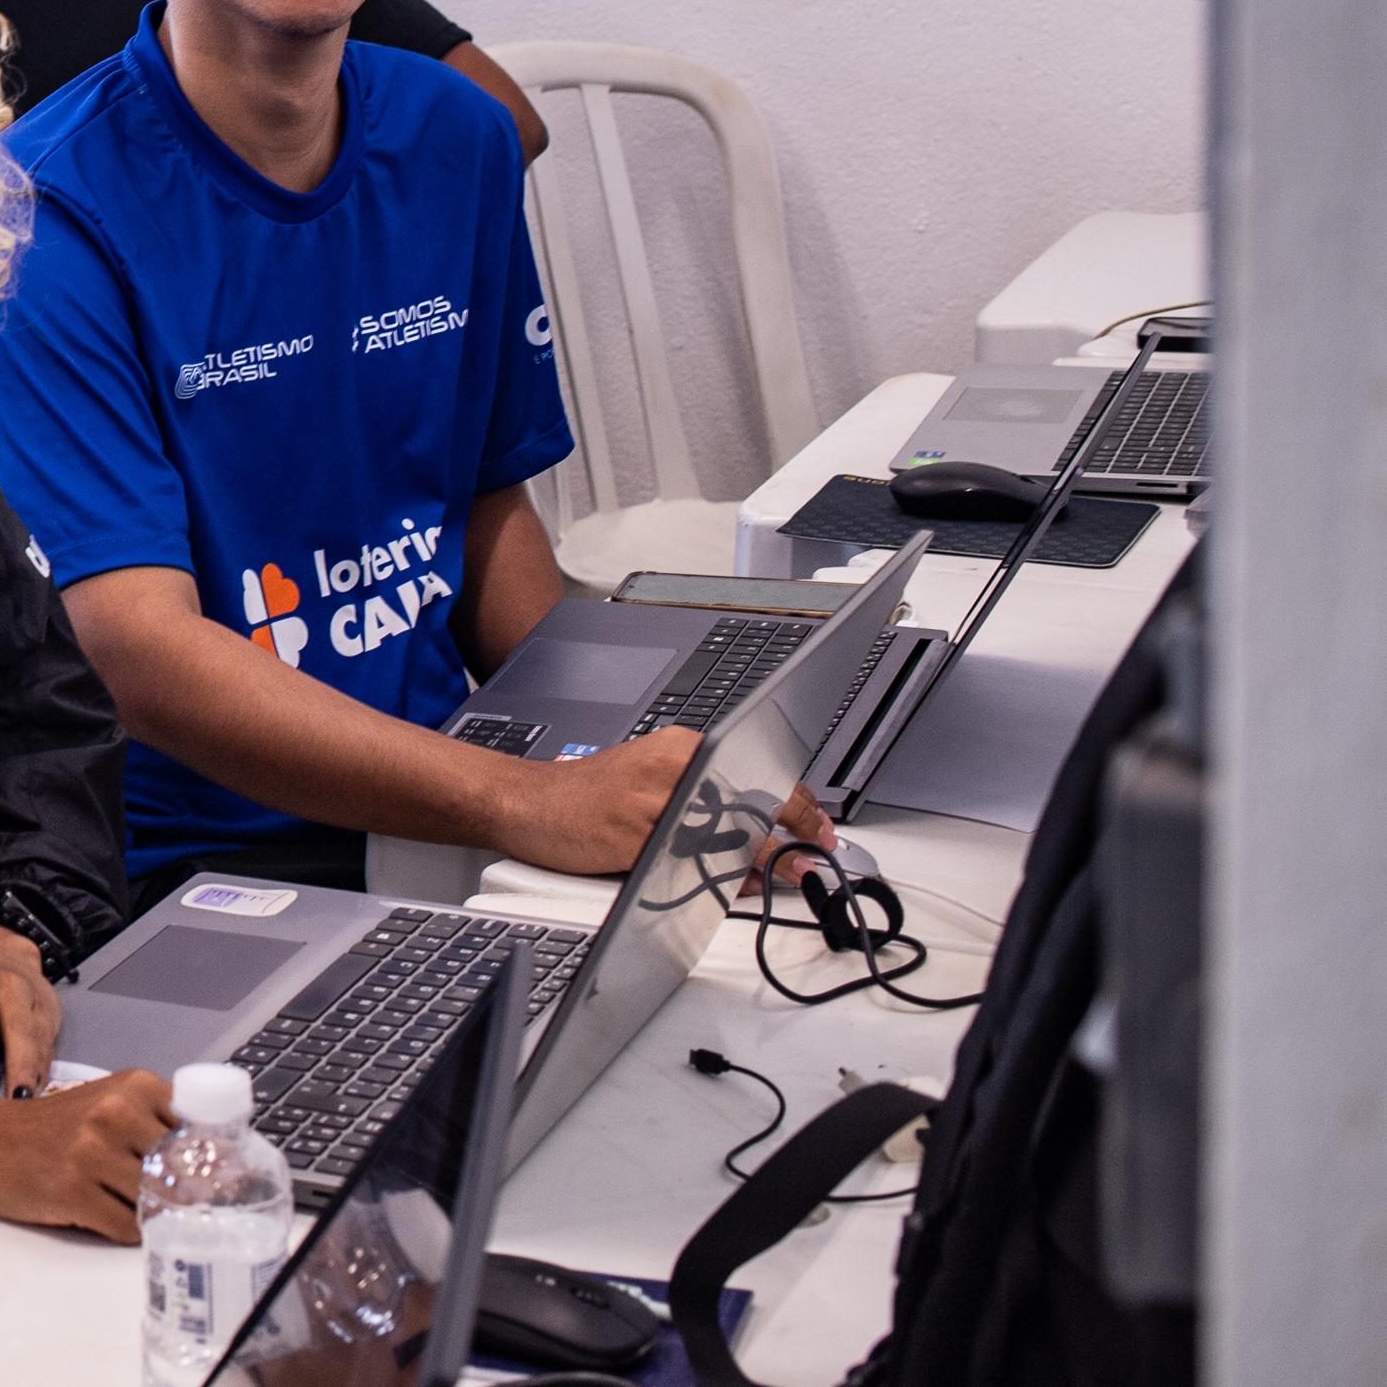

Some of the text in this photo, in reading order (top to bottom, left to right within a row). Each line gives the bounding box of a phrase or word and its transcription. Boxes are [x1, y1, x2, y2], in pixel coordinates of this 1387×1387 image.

[359, 295, 452, 335] SOMOS
[364, 308, 469, 354] ATLETISM
[203, 334, 315, 372] TLETISMO
[313, 517, 444, 599] loteri
